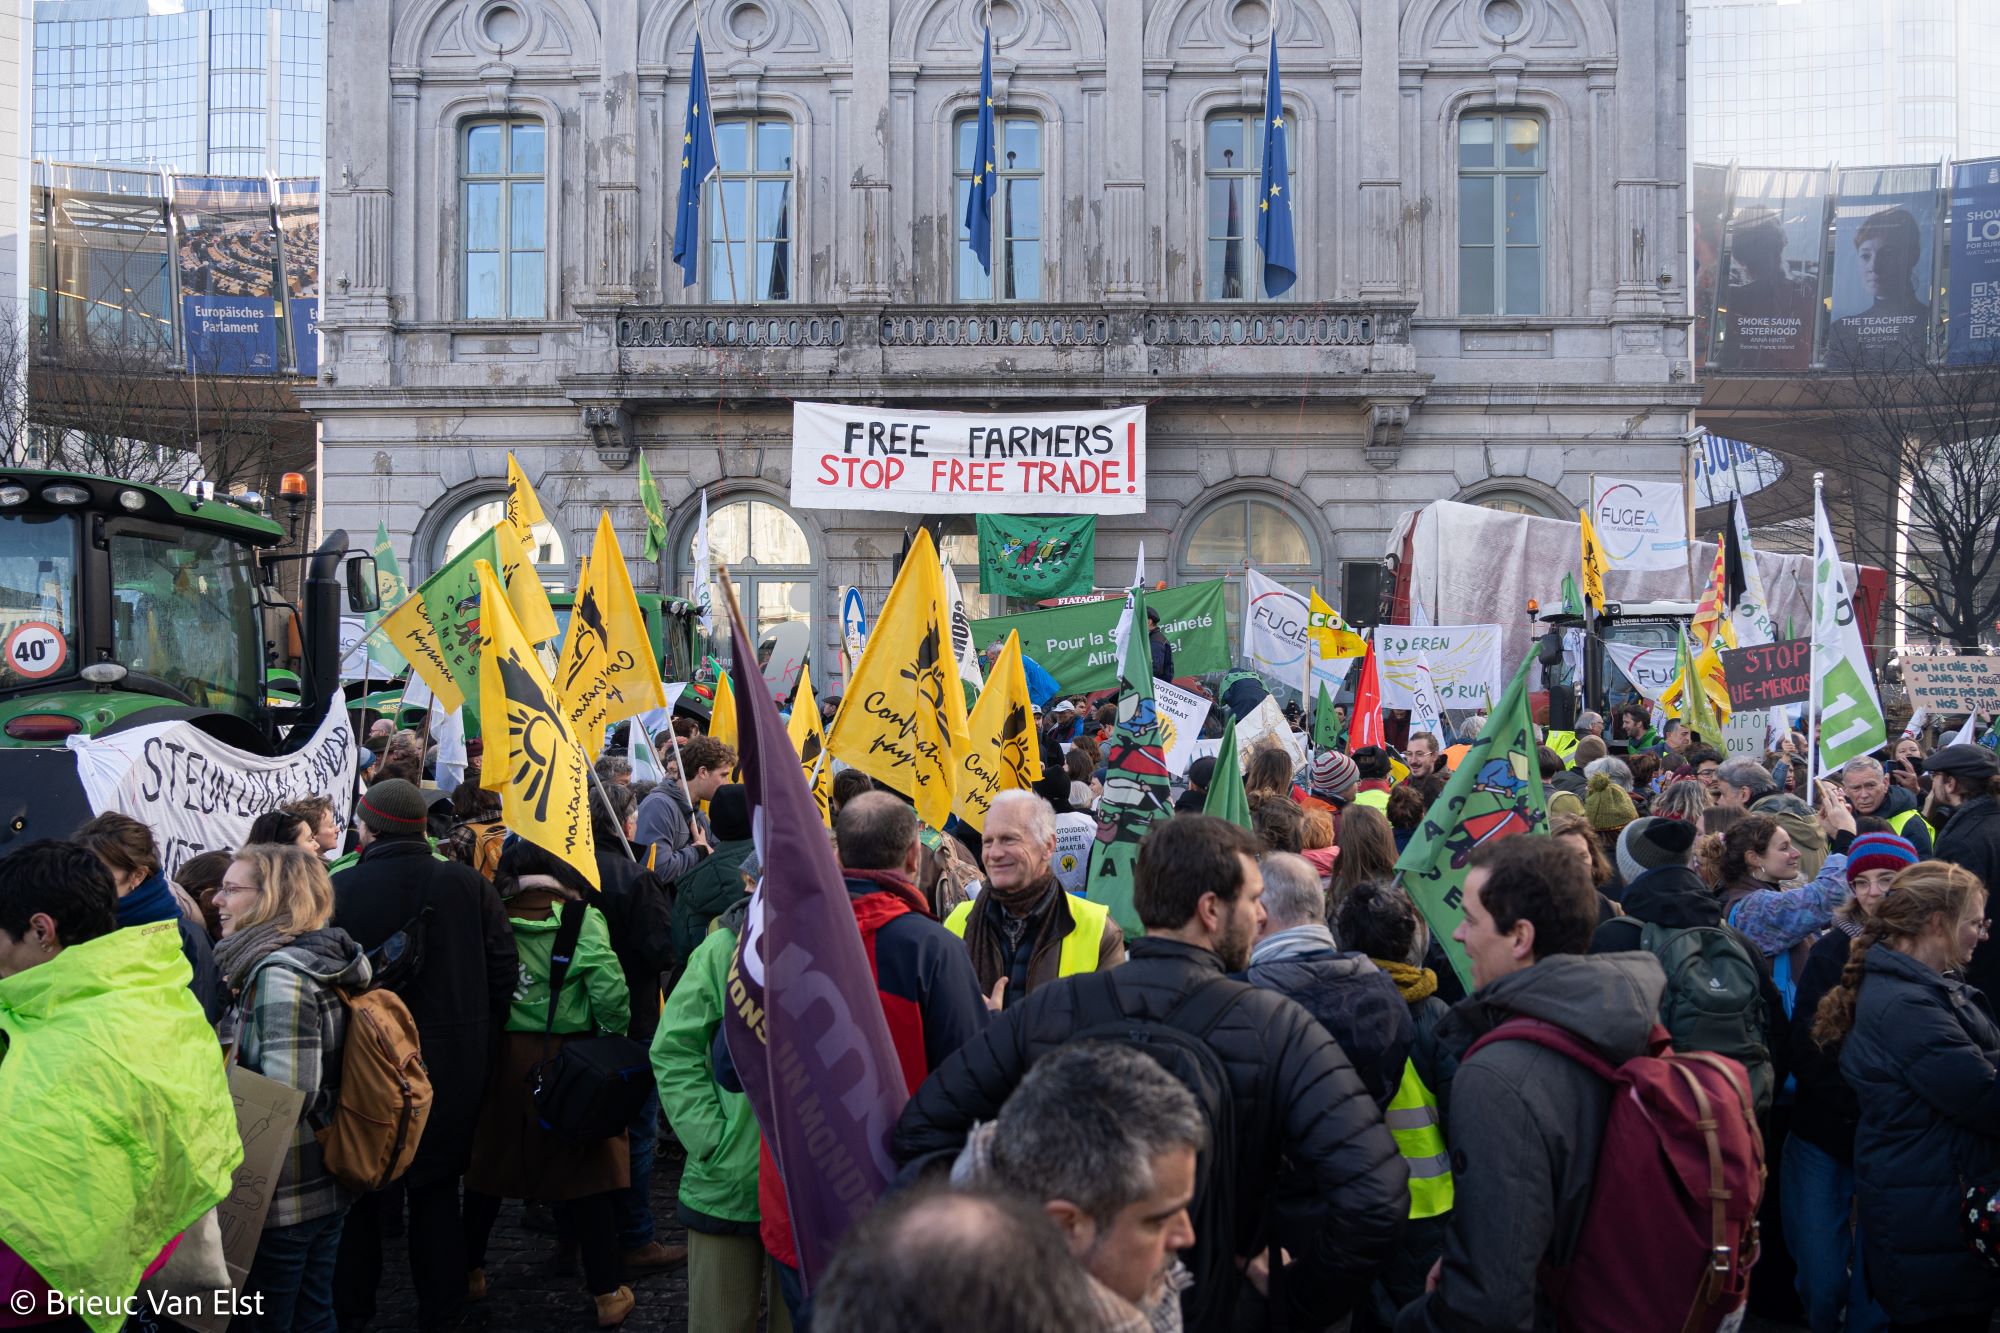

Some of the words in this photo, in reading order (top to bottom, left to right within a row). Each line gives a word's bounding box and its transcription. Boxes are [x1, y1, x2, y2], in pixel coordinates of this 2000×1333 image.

[1967, 220, 2000, 242] LO
[195, 305, 264, 319] Europäisches
[202, 321, 259, 333] Parlament
[1737, 318, 1769, 326] SMOKE
[1771, 318, 1801, 326] SAUNA
[1842, 317, 1861, 326] THE
[1863, 315, 1917, 325] TEACHERS'
[1740, 327, 1797, 336] SISTERHOOD
[1858, 325, 1900, 335] LOUNGE
[844, 422, 931, 457] FREE
[969, 425, 1114, 458] FARMERS
[816, 454, 905, 490] STOP
[931, 459, 1006, 492] FREE
[1601, 507, 1659, 526] FUGEA
[1254, 606, 1309, 644] FUGE
[1046, 636, 1085, 653] Pour
[1089, 634, 1103, 646] la
[15, 640, 46, 662] 40
[1745, 642, 1808, 673] STOP
[1911, 663, 1928, 672] ON
[1931, 663, 1945, 672] NE
[1970, 663, 1988, 673] PAS
[1927, 674, 1954, 683] DANS
[1956, 675, 1973, 683] VOS
[1153, 683, 1198, 706] OOTOUDERS
[1730, 673, 1811, 705] UE-MERCOS
[1915, 688, 1928, 696] NE
[1929, 687, 1958, 696] CHIEZ
[1959, 688, 1976, 697] PAS
[1977, 688, 1997, 697] SUR
[1160, 694, 1178, 707] VOOR
[1935, 699, 1958, 709] NOS
[1158, 703, 1189, 720] KLIMAAT
[141, 737, 234, 815] STEUN
[1056, 826, 1089, 835] OTOUDERS
[1055, 844, 1086, 852] LIMAAT.BE
